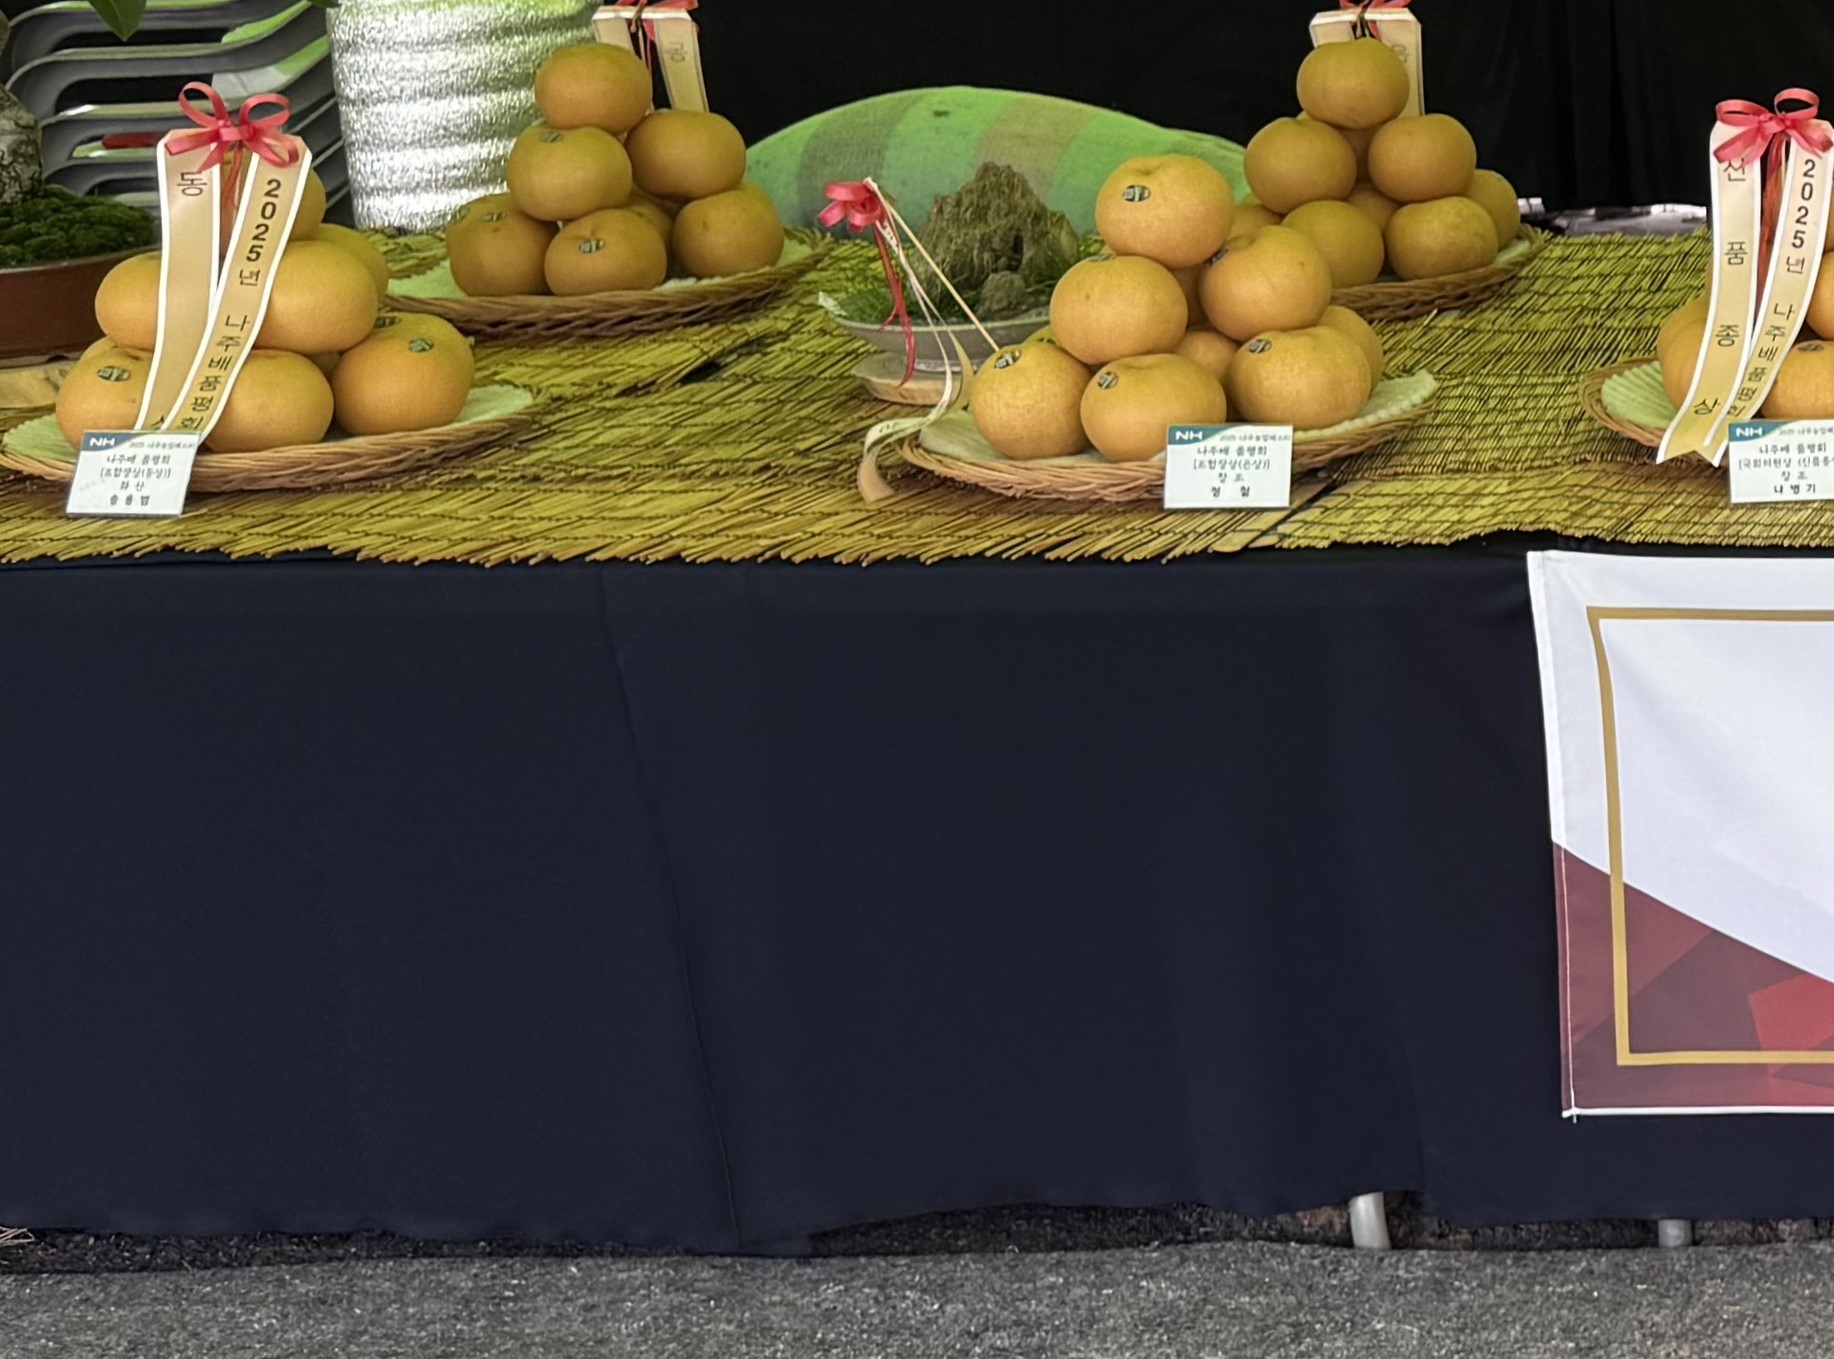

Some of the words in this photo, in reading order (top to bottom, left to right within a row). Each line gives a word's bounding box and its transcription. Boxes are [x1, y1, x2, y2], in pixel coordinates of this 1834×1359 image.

[176, 170, 208, 197] 동
[1785, 157, 1818, 276] 2025년
[239, 177, 283, 287] 2025년
[1723, 240, 1748, 267] 품
[1714, 323, 1741, 348] 종
[1726, 301, 1797, 418] 나주배품평회
[178, 313, 251, 432] 나주배품평회
[1693, 396, 1720, 417] 상
[90, 437, 115, 447] NH
[1175, 431, 1203, 440] NH
[1736, 427, 1763, 437] NH
[107, 454, 136, 464] 나주배
[1197, 446, 1229, 456] 나주배
[1760, 444, 1790, 454] 나주배
